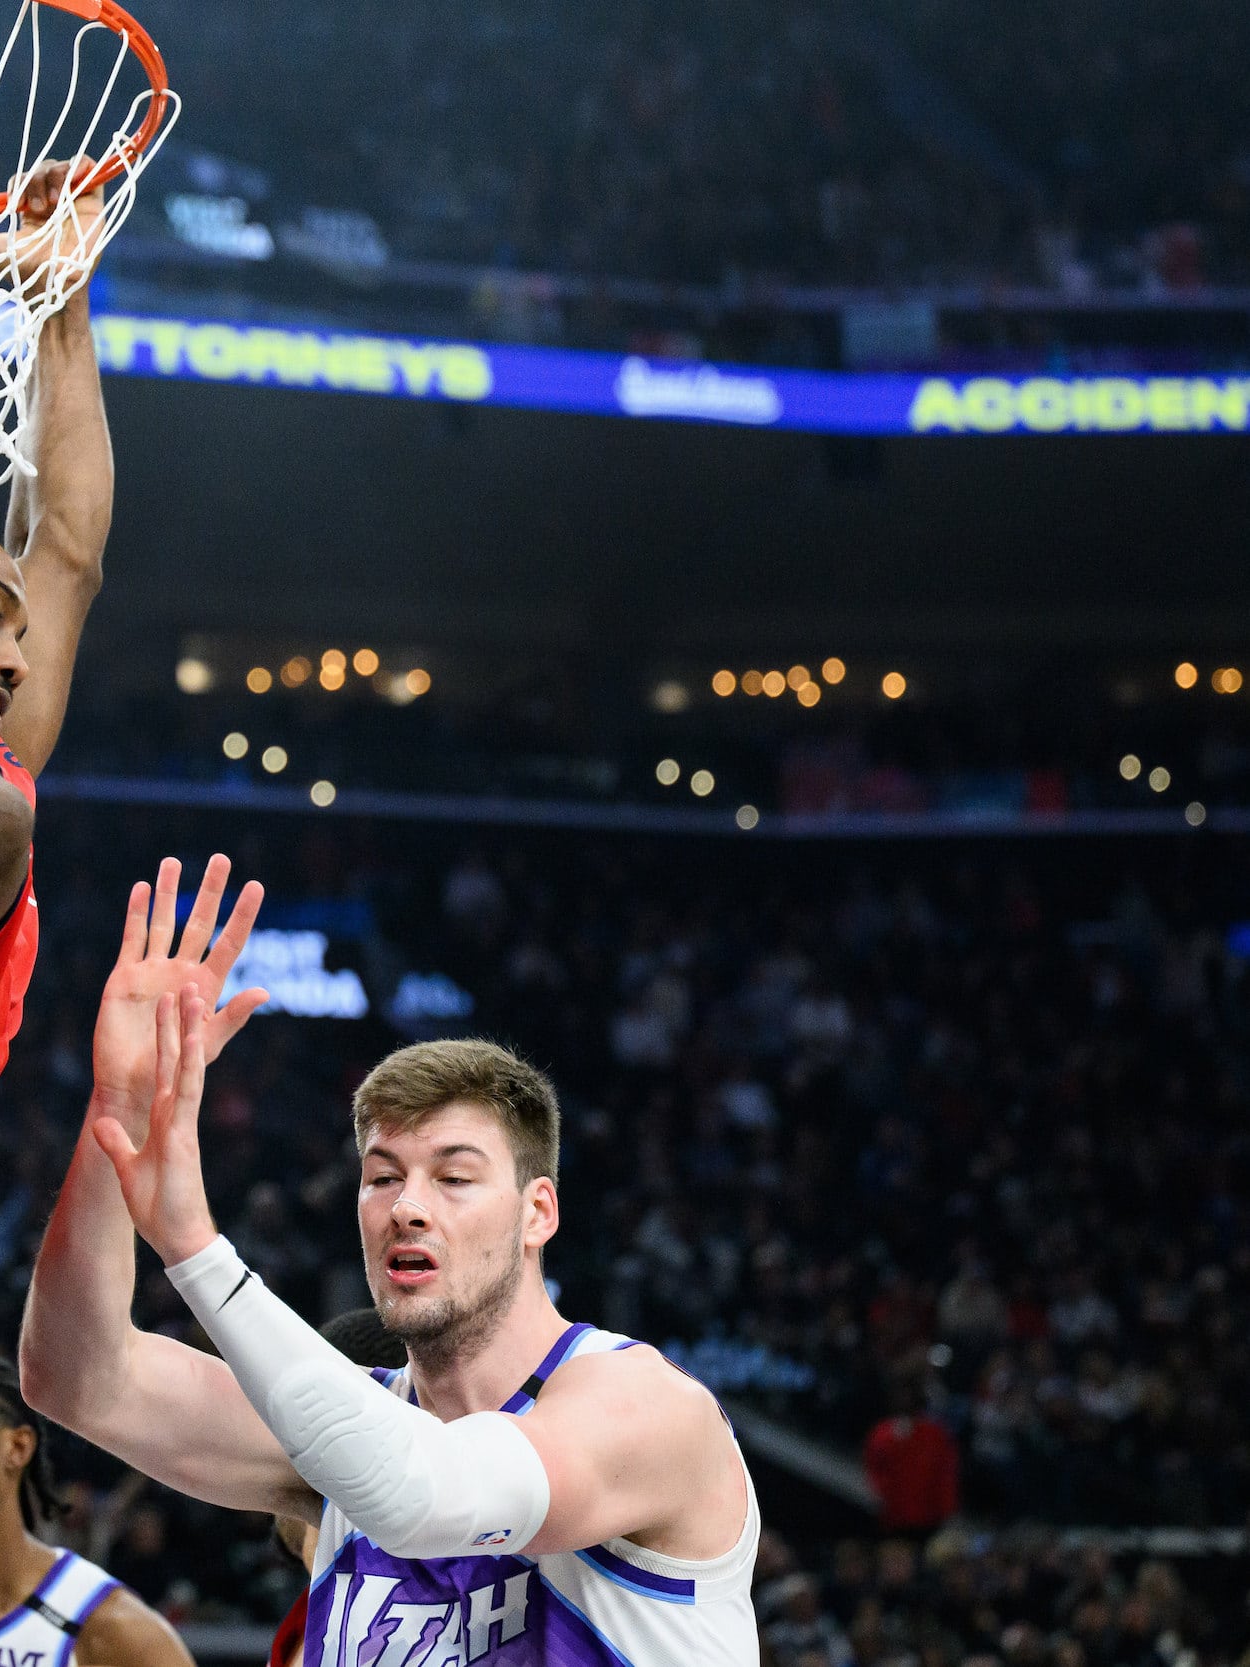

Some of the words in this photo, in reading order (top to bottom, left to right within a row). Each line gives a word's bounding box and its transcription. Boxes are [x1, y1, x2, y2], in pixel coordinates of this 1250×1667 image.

[91, 315, 493, 400] TTORNEYS
[910, 377, 1250, 432] ACCIDEN
[319, 1569, 534, 1667] UTAH
